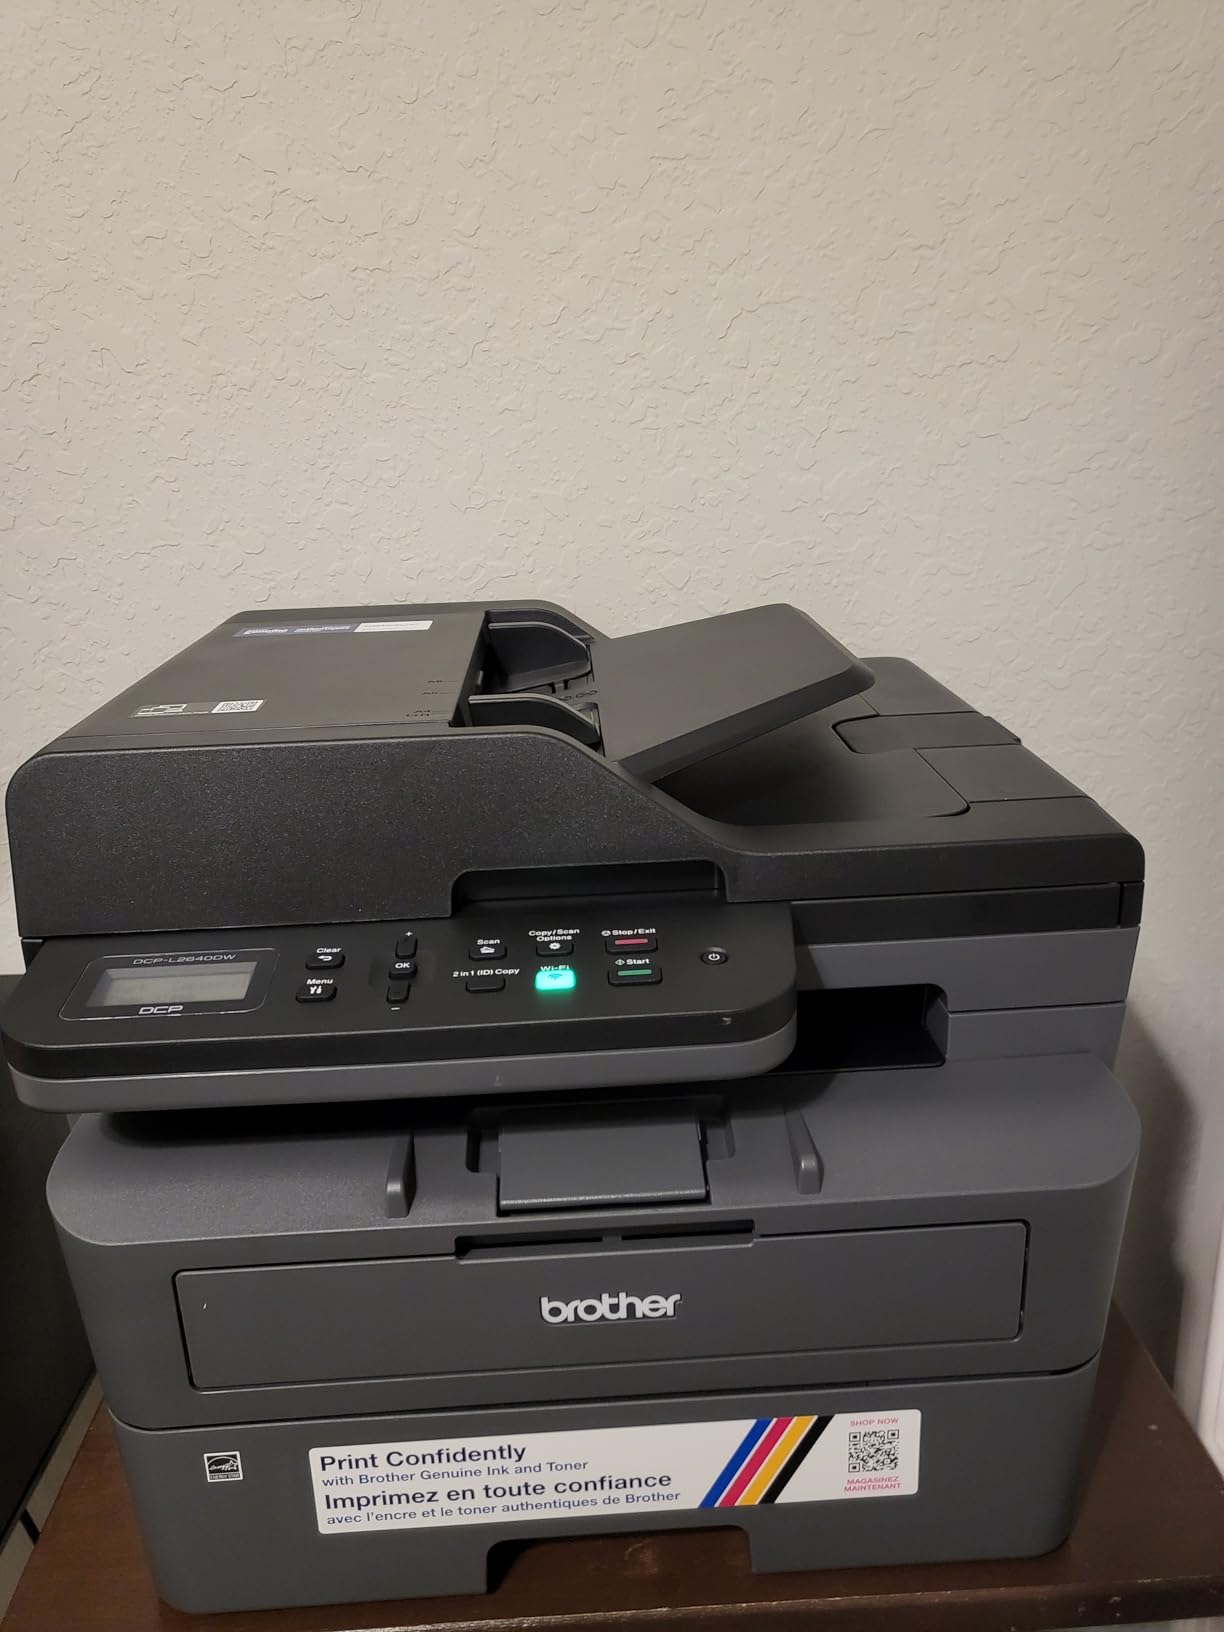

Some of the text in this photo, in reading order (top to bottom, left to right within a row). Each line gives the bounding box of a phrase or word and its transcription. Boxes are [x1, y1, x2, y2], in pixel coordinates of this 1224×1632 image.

[528, 928, 580, 937] Copy/Scan
[612, 927, 656, 936] Stop/Exit
[495, 967, 520, 975] Copy
[138, 1005, 184, 1015] DCP
[540, 1292, 681, 1323] brother
[320, 1444, 526, 1471] Print Confidently
[322, 1461, 588, 1487] with Brother Genuine Ink and Toner
[846, 1476, 899, 1485] MAGASINEZ
[325, 1474, 672, 1511] Imprimez en toute confiance
[843, 1483, 901, 1492] MAINTENANT
[327, 1491, 681, 1525] avec l'encre et le toner authentiques de Brother
